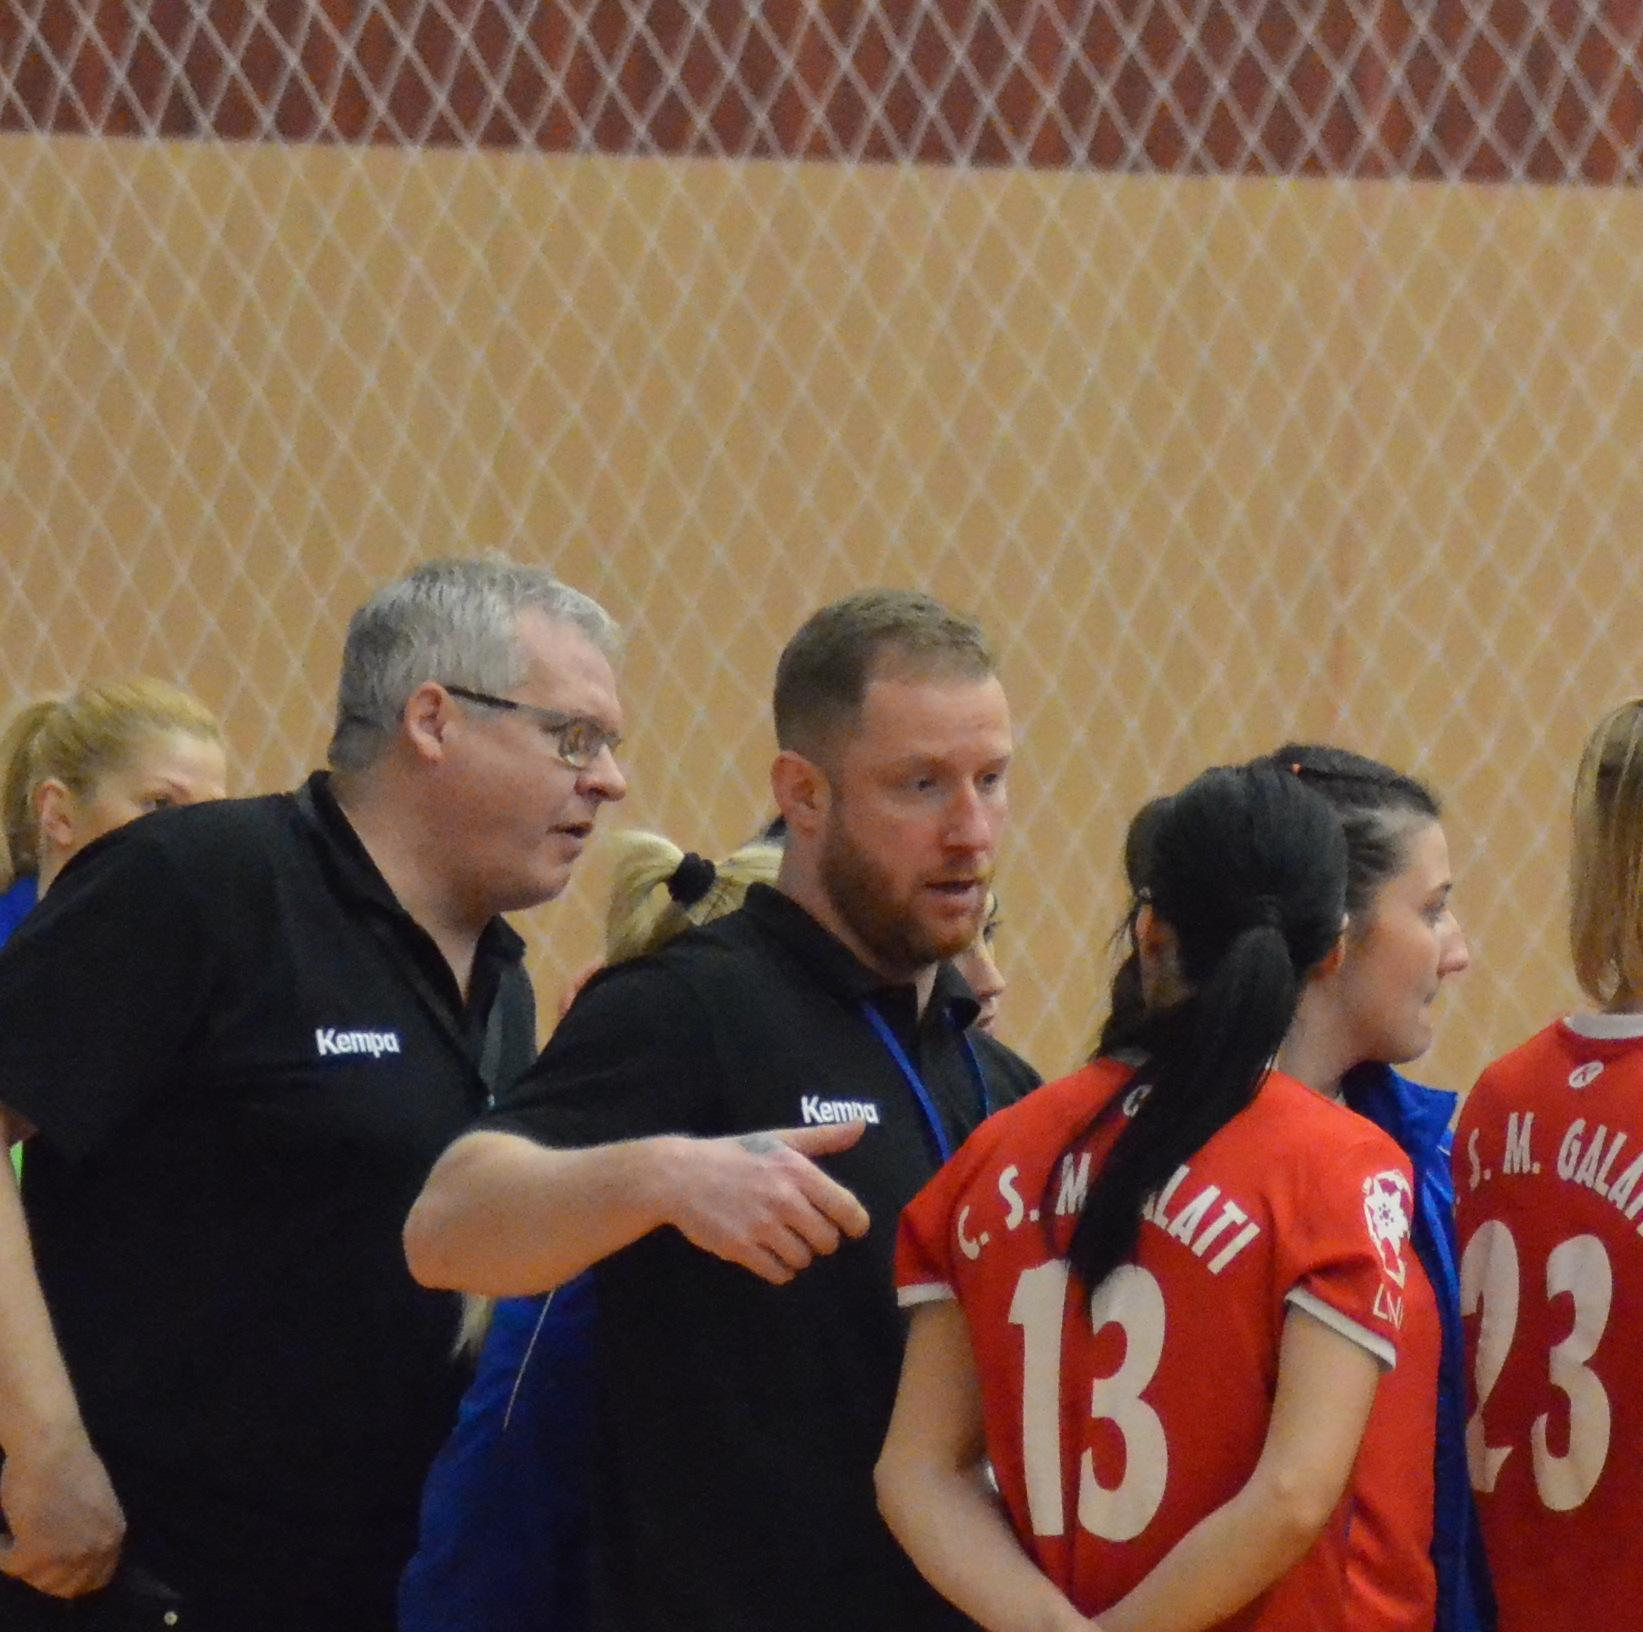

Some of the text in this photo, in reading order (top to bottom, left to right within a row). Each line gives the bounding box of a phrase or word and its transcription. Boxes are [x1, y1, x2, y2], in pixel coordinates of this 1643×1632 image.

[314, 1027, 401, 1059] Kempa
[1503, 1111, 1543, 1175] M.
[957, 1205, 990, 1261] C.
[998, 1164, 1041, 1232] S.
[1055, 1151, 1093, 1217] M
[1008, 1258, 1169, 1542] 13
[1459, 1218, 1614, 1513] 23
